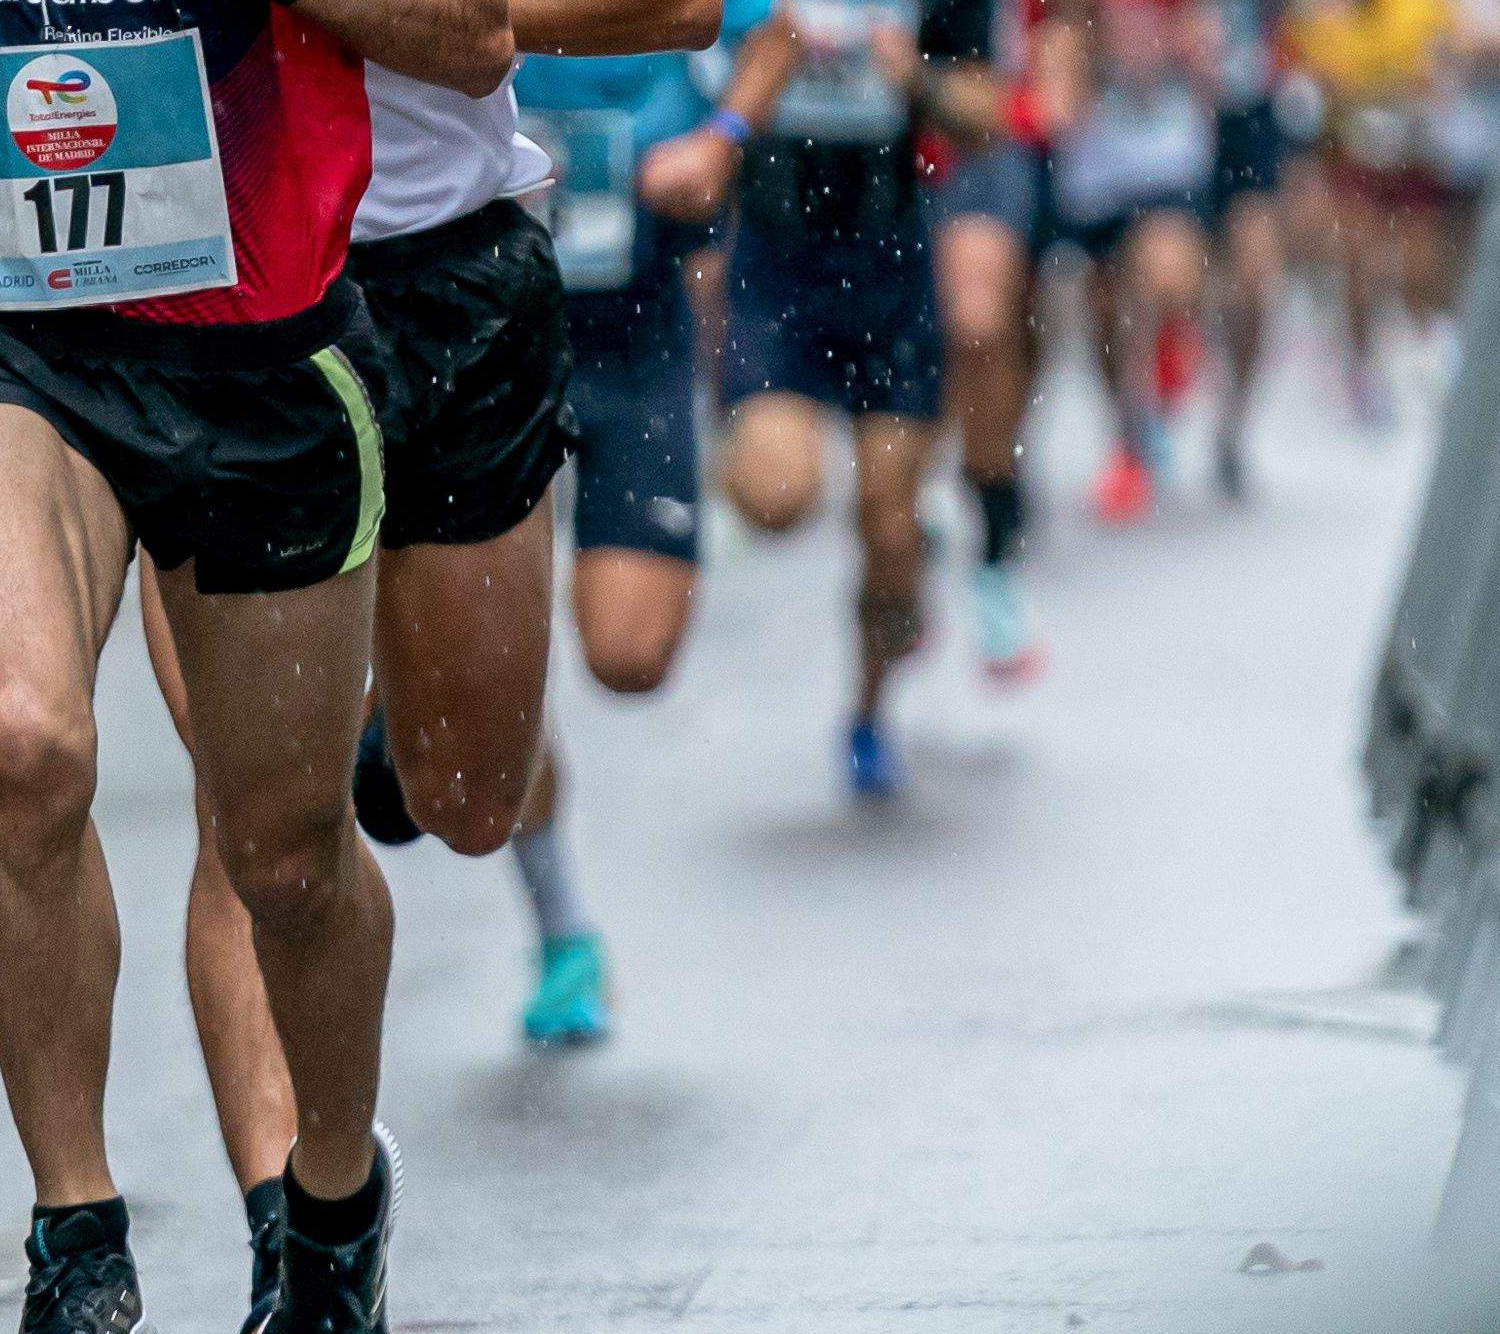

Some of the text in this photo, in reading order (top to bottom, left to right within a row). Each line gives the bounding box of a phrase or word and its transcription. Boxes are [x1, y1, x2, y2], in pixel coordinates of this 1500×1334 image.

[29, 109, 97, 122] TotalEnergies
[46, 130, 81, 141] MILLA
[38, 149, 96, 163] DE MADRID
[23, 171, 126, 255] 177
[73, 265, 112, 278] MILLA
